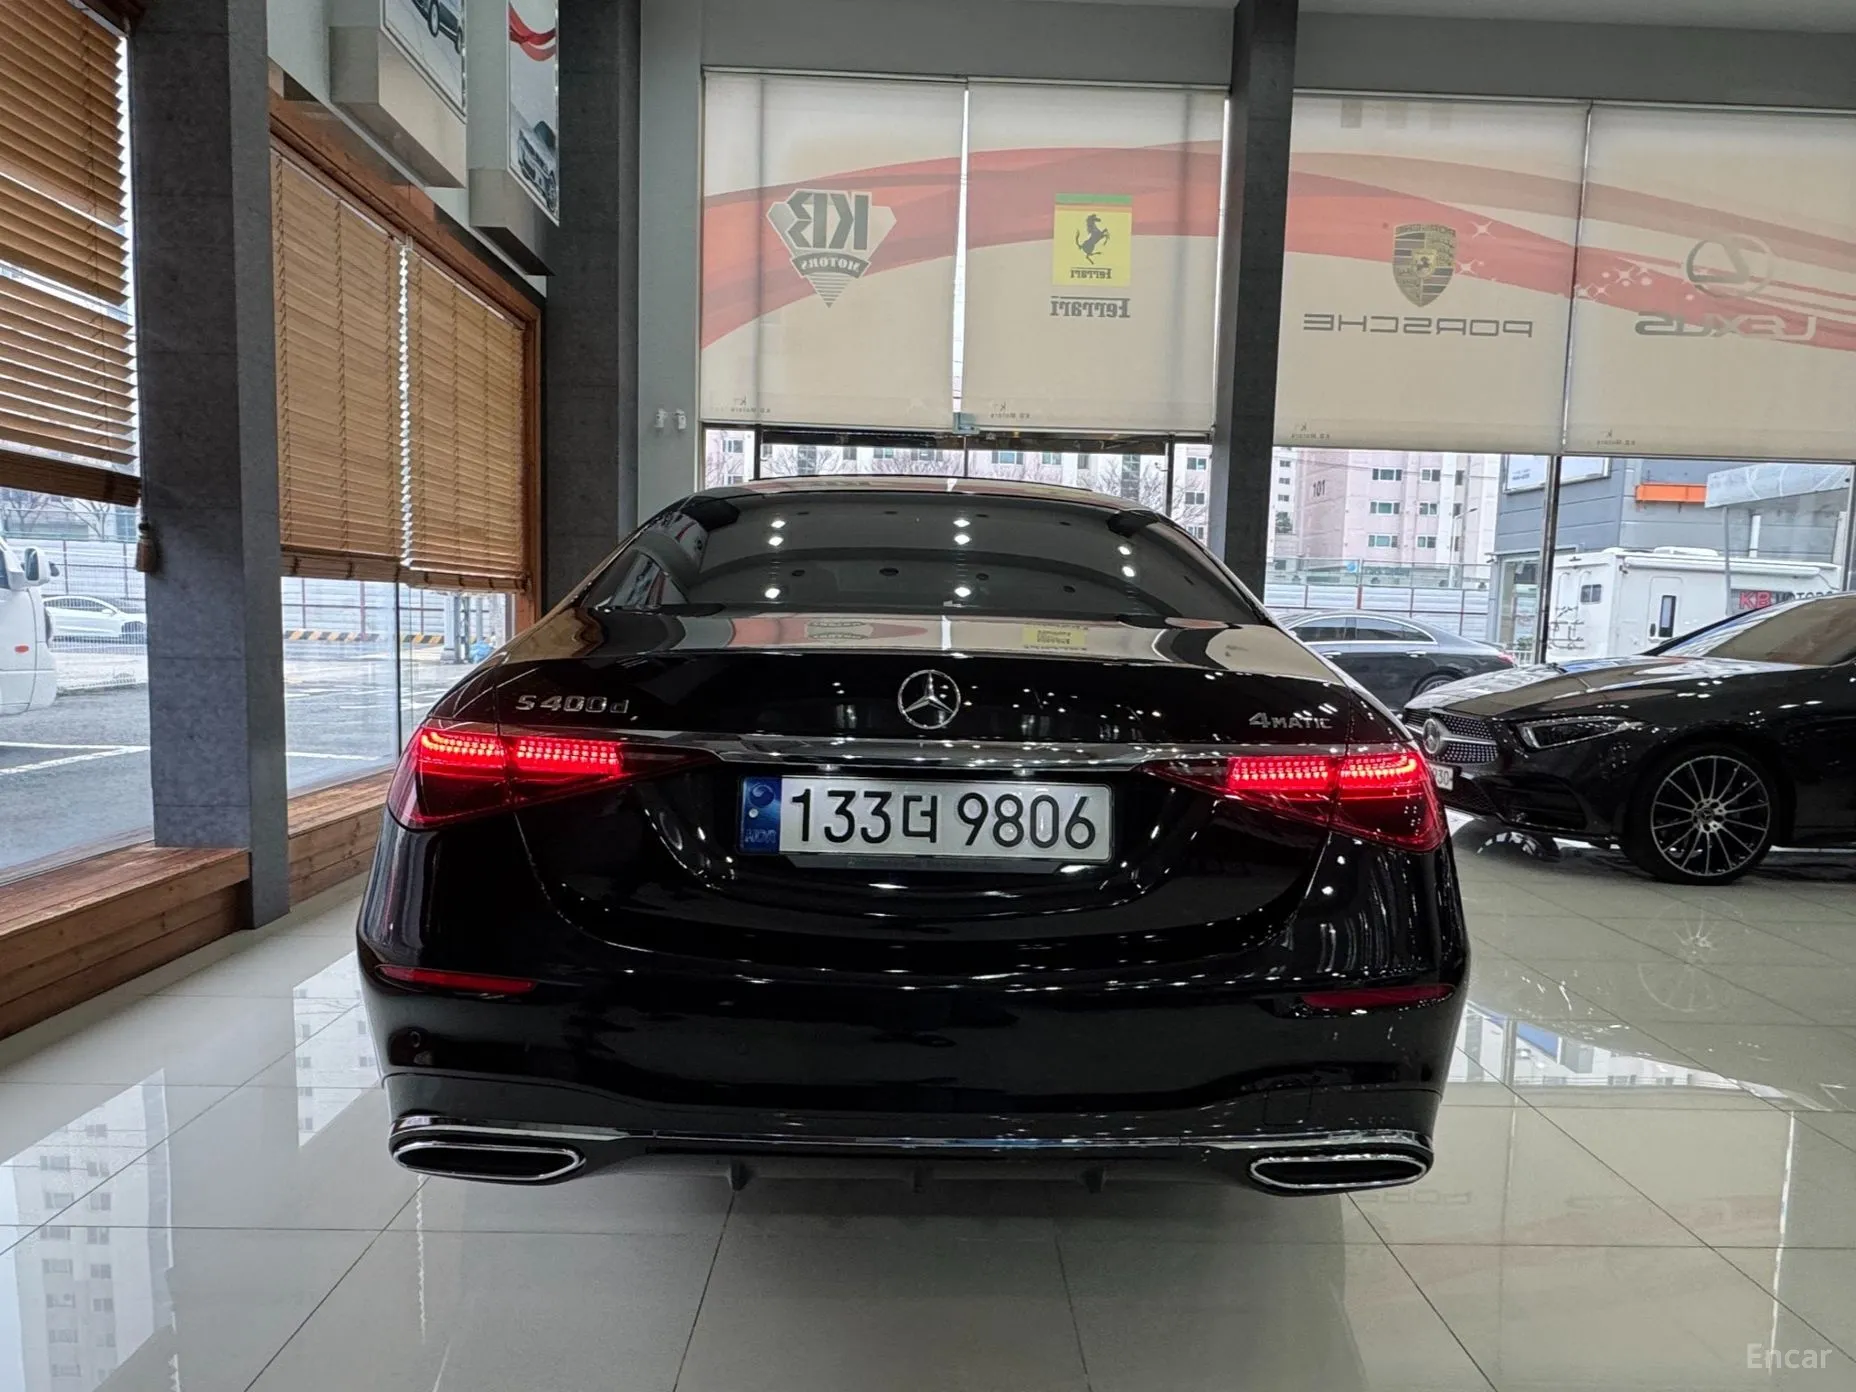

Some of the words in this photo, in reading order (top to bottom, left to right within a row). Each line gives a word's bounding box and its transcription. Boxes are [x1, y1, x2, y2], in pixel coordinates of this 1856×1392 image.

[1739, 591, 1773, 610] KB
[1248, 711, 1334, 729] 4MATIC
[791, 787, 938, 845] 133더
[956, 791, 1097, 851] 9806
